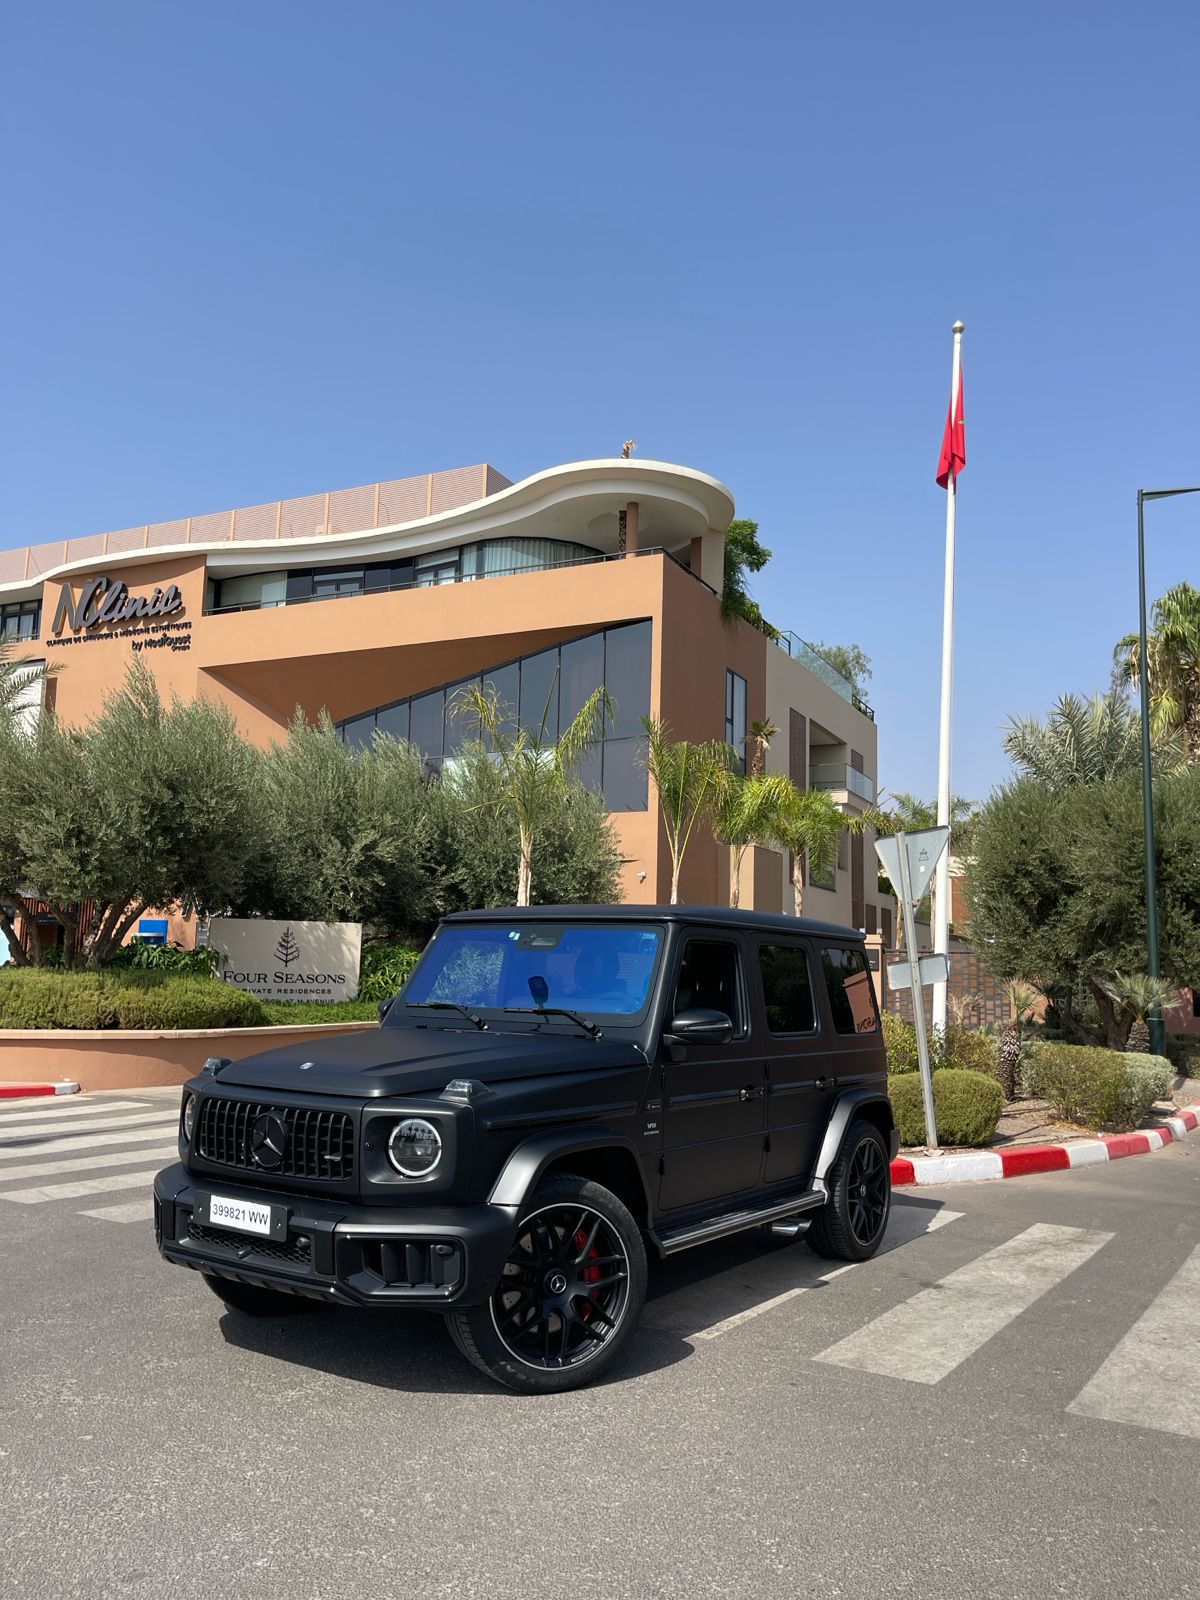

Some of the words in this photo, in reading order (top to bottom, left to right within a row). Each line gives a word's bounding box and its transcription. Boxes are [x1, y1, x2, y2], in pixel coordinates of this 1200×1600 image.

[132, 640, 143, 652] by
[223, 971, 268, 983] FOUR
[273, 971, 346, 985] SEASONS
[212, 1204, 245, 1221] 399821
[248, 1210, 269, 1226] WW
